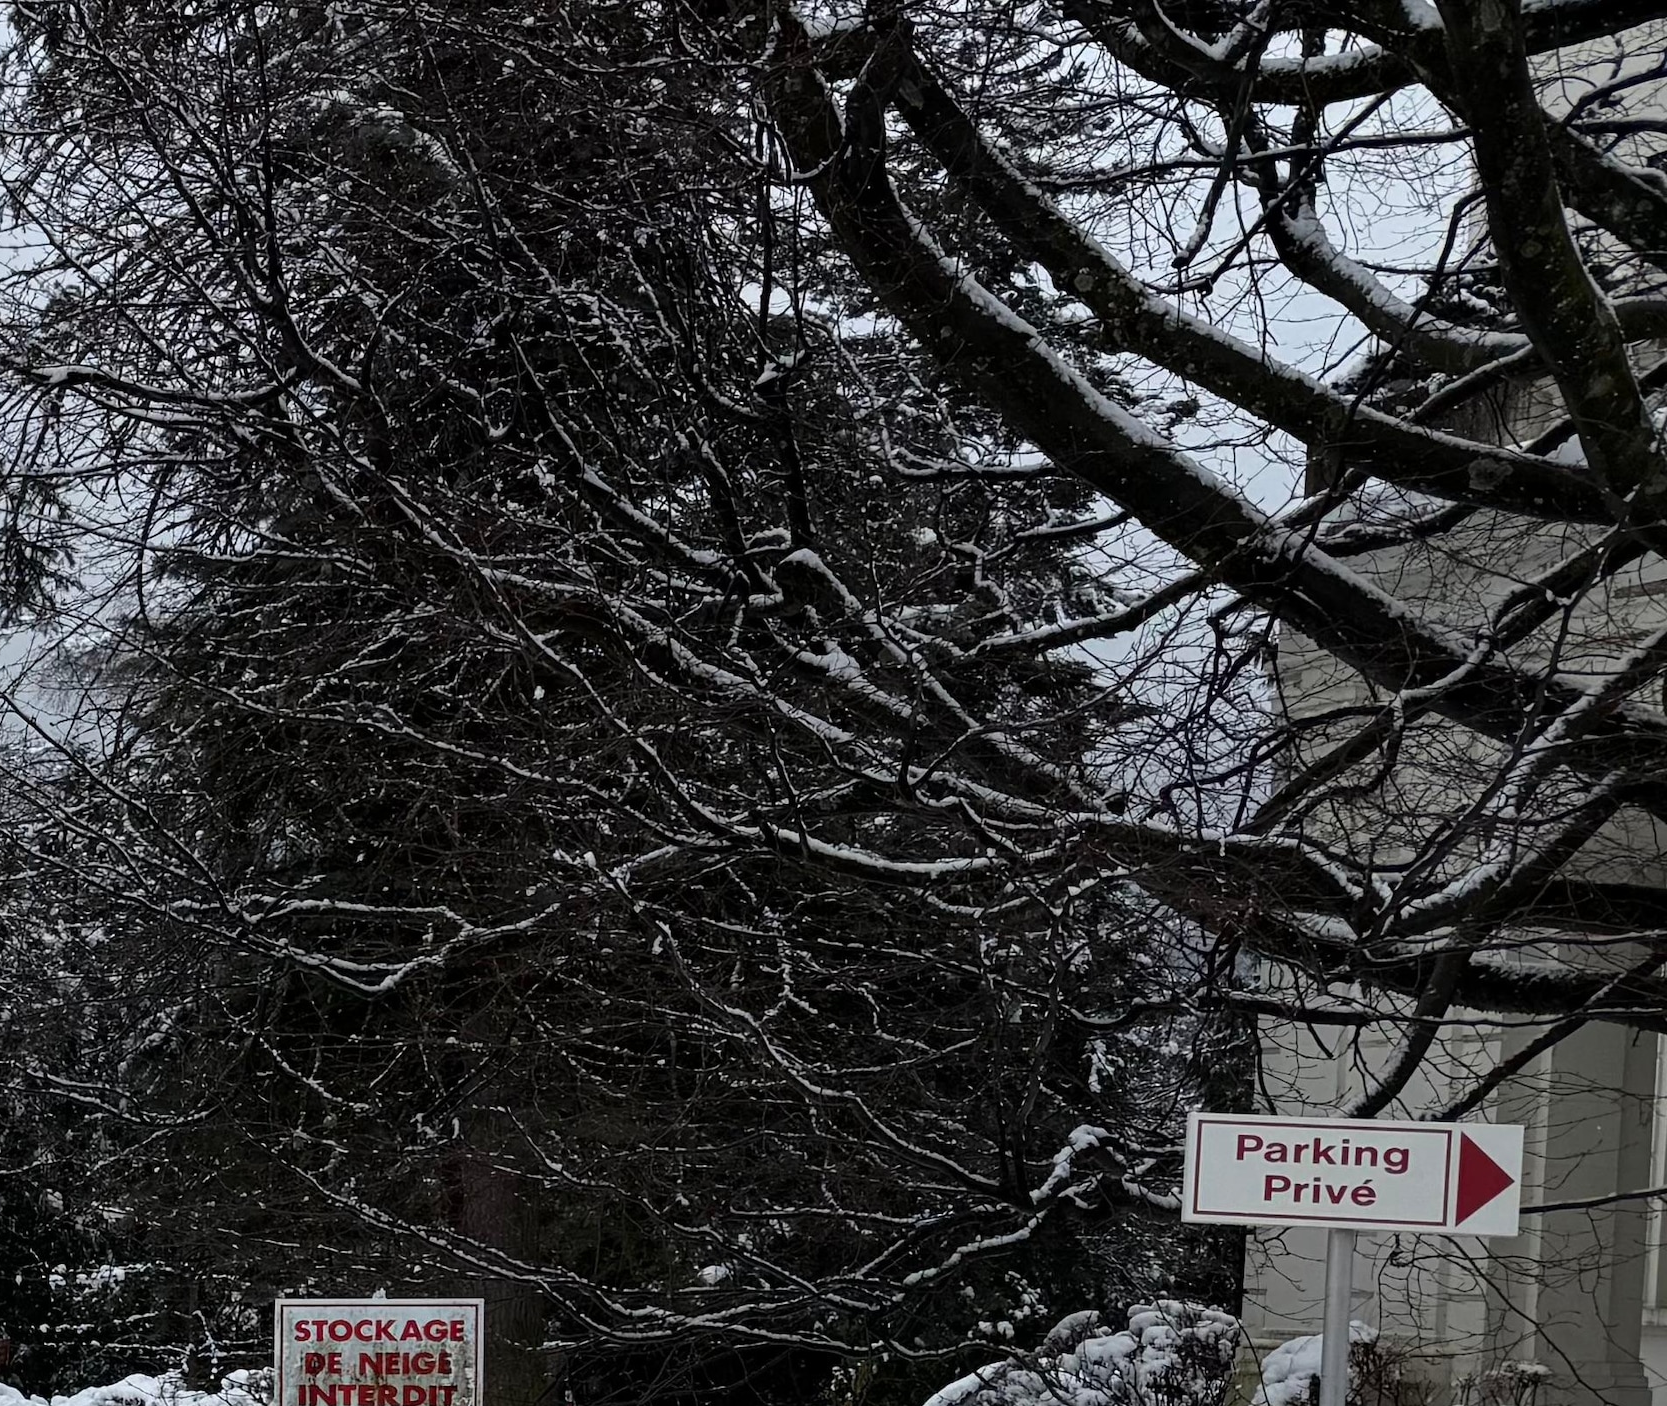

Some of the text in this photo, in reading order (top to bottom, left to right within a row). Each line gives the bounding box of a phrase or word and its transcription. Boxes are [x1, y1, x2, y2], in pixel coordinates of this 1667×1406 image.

[1236, 1134, 1410, 1174] Parking
[1263, 1174, 1377, 1206] Privé
[294, 1319, 465, 1342] STOCKAGE
[304, 1351, 452, 1375] DE NEIGE
[298, 1384, 458, 1406] INTERDIT
